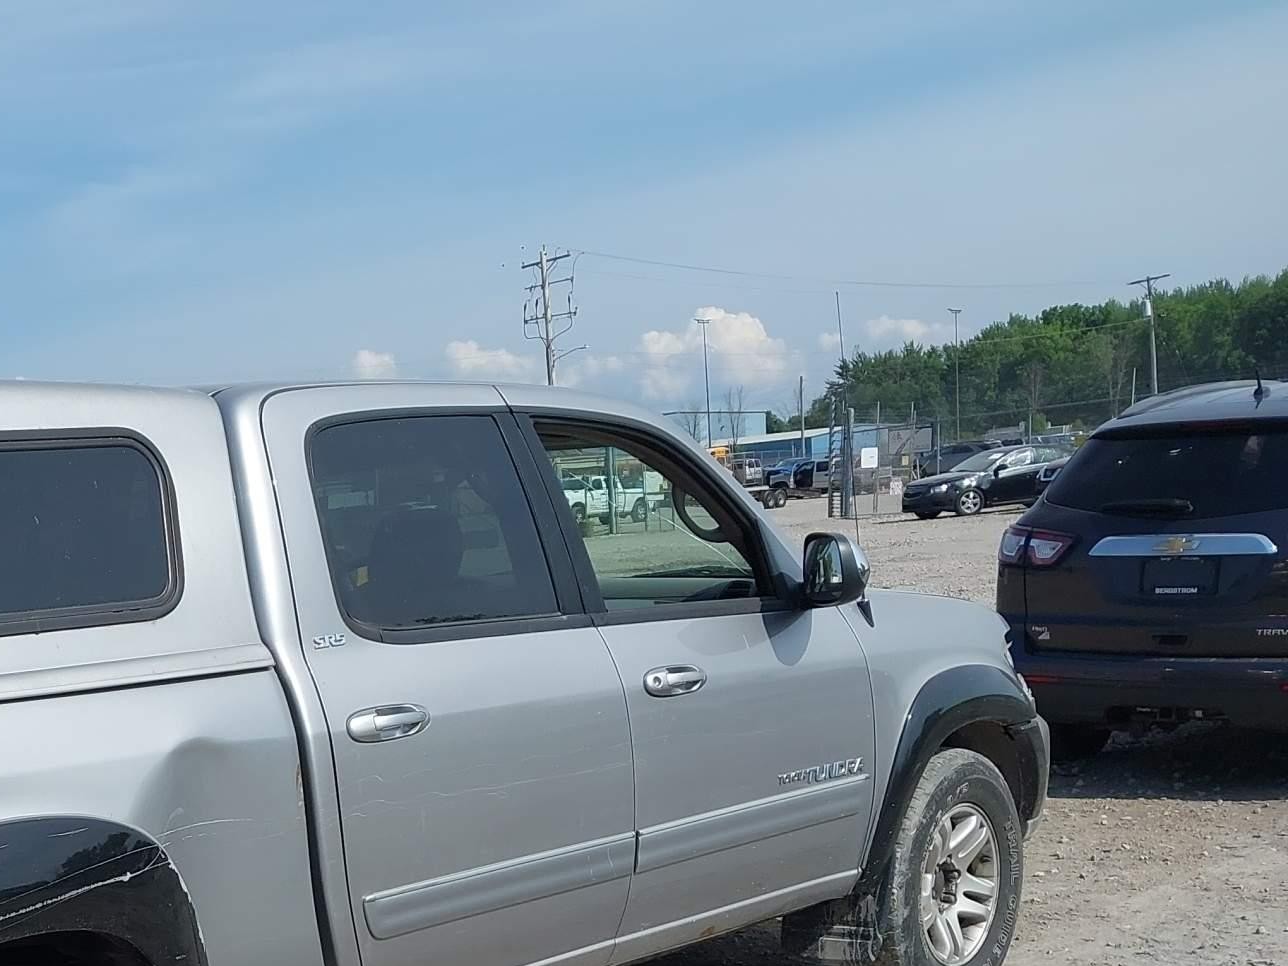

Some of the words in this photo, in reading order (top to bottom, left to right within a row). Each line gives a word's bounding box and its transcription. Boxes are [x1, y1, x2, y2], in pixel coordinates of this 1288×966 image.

[312, 633, 346, 650] SR5
[807, 757, 864, 784] TUNDRA
[992, 895, 1017, 958] GUIDE
